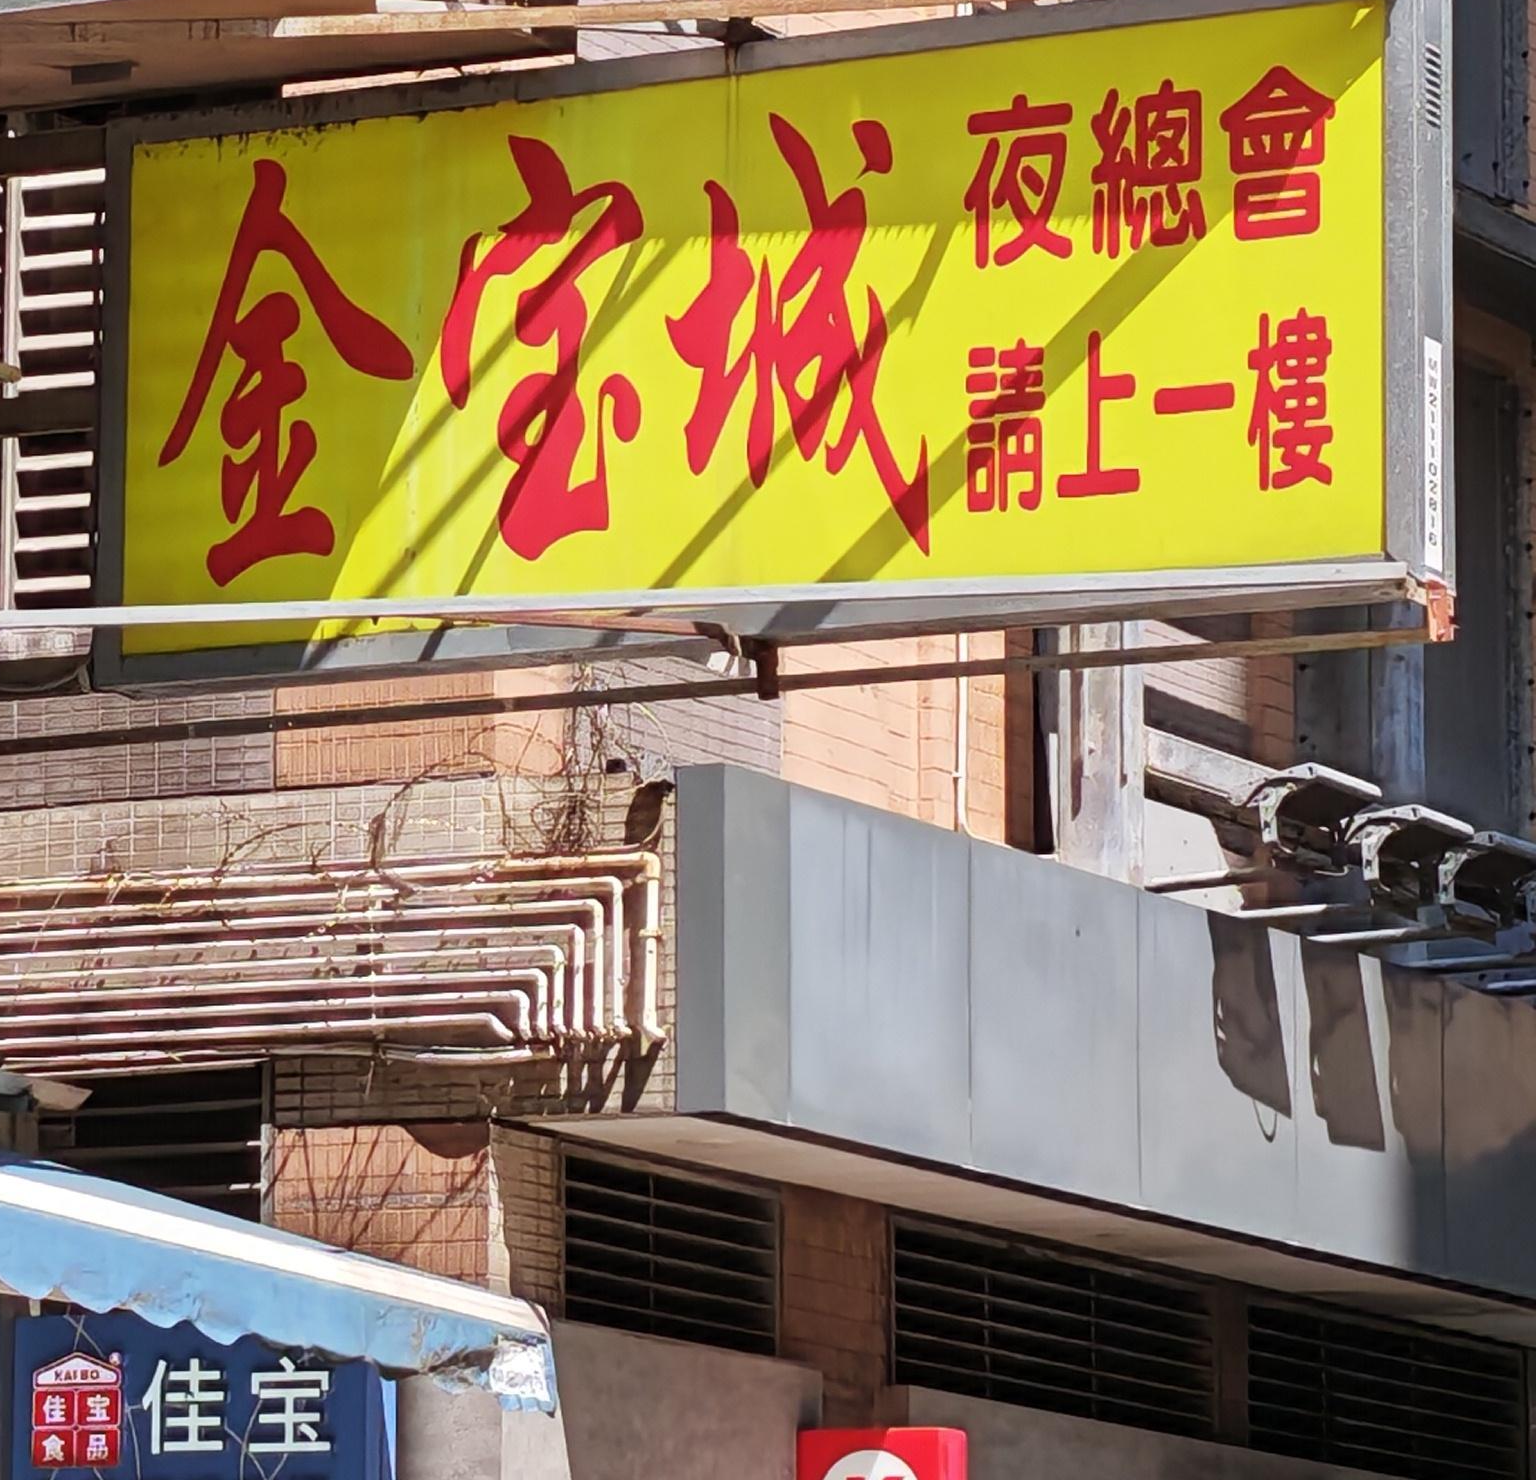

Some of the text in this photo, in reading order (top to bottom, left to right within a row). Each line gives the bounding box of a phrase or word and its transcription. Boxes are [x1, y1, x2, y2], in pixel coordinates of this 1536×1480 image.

[963, 63, 1339, 270] 夜總會
[157, 110, 930, 589] 金宝城
[963, 305, 1337, 516] 請上一樓
[41, 1432, 110, 1463] 食品
[42, 1393, 112, 1424] 佳宝
[142, 1356, 333, 1455] 佳宝
